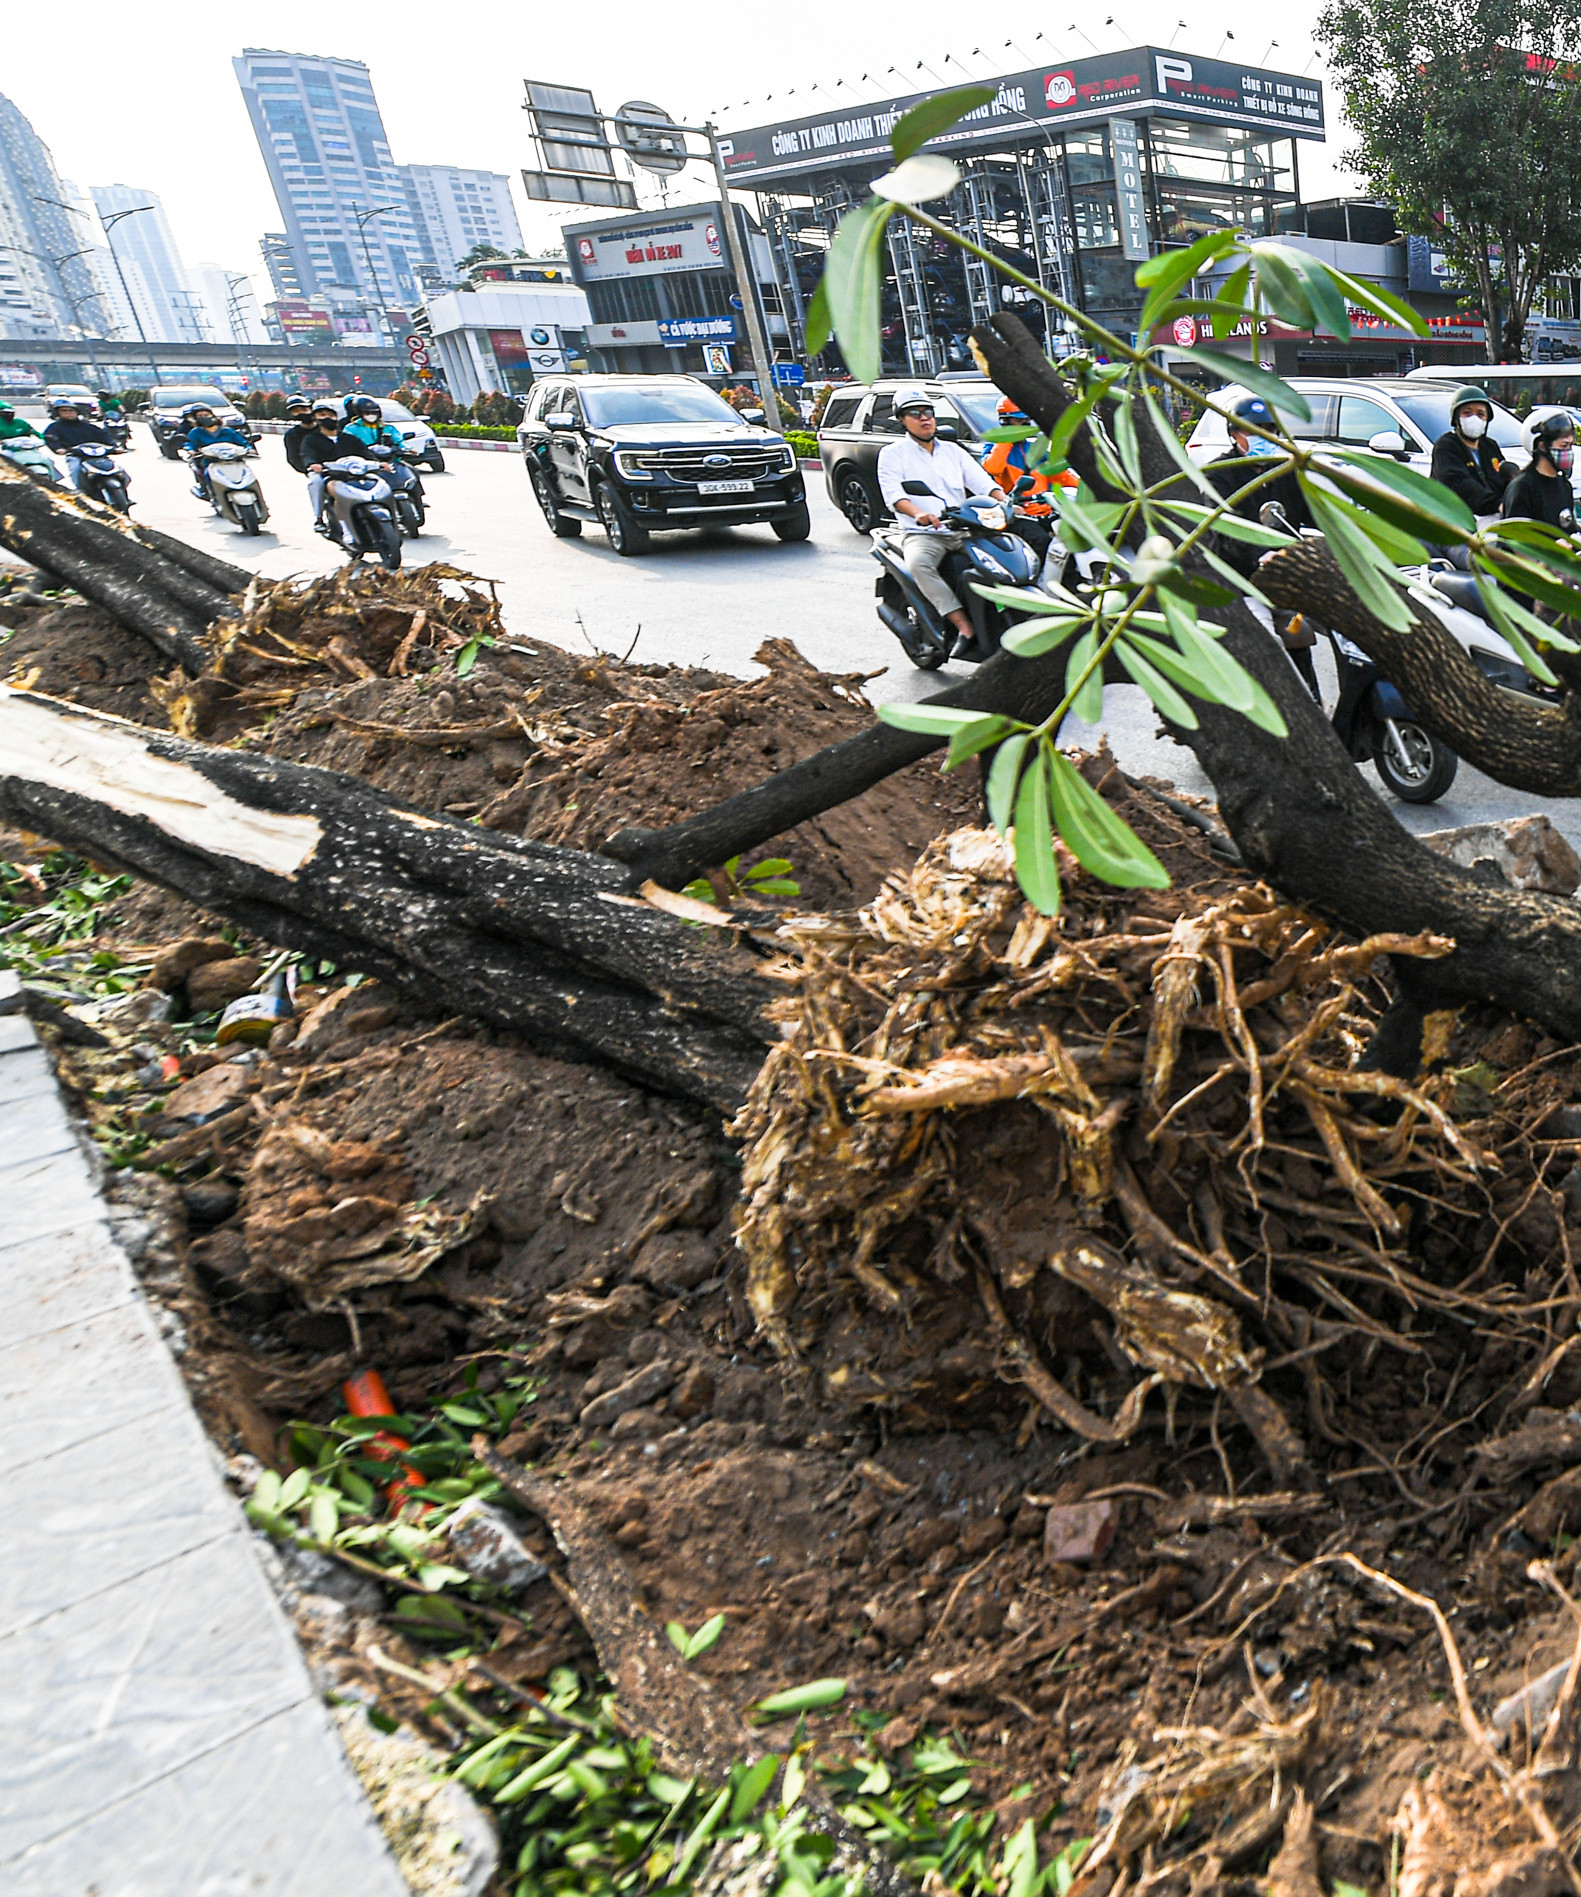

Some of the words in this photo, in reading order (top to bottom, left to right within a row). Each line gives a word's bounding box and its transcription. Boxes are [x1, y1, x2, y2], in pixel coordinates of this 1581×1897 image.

[1090, 87, 1141, 102] Corporation
[1241, 75, 1262, 92] CÔNG
[1264, 81, 1273, 93] TY
[1276, 83, 1293, 97] KINH
[771, 130, 799, 156] CÔNG
[799, 130, 811, 151] TY
[812, 124, 836, 148] KINH
[837, 117, 873, 142] DOANH
[1120, 152, 1142, 249] MOTEL
